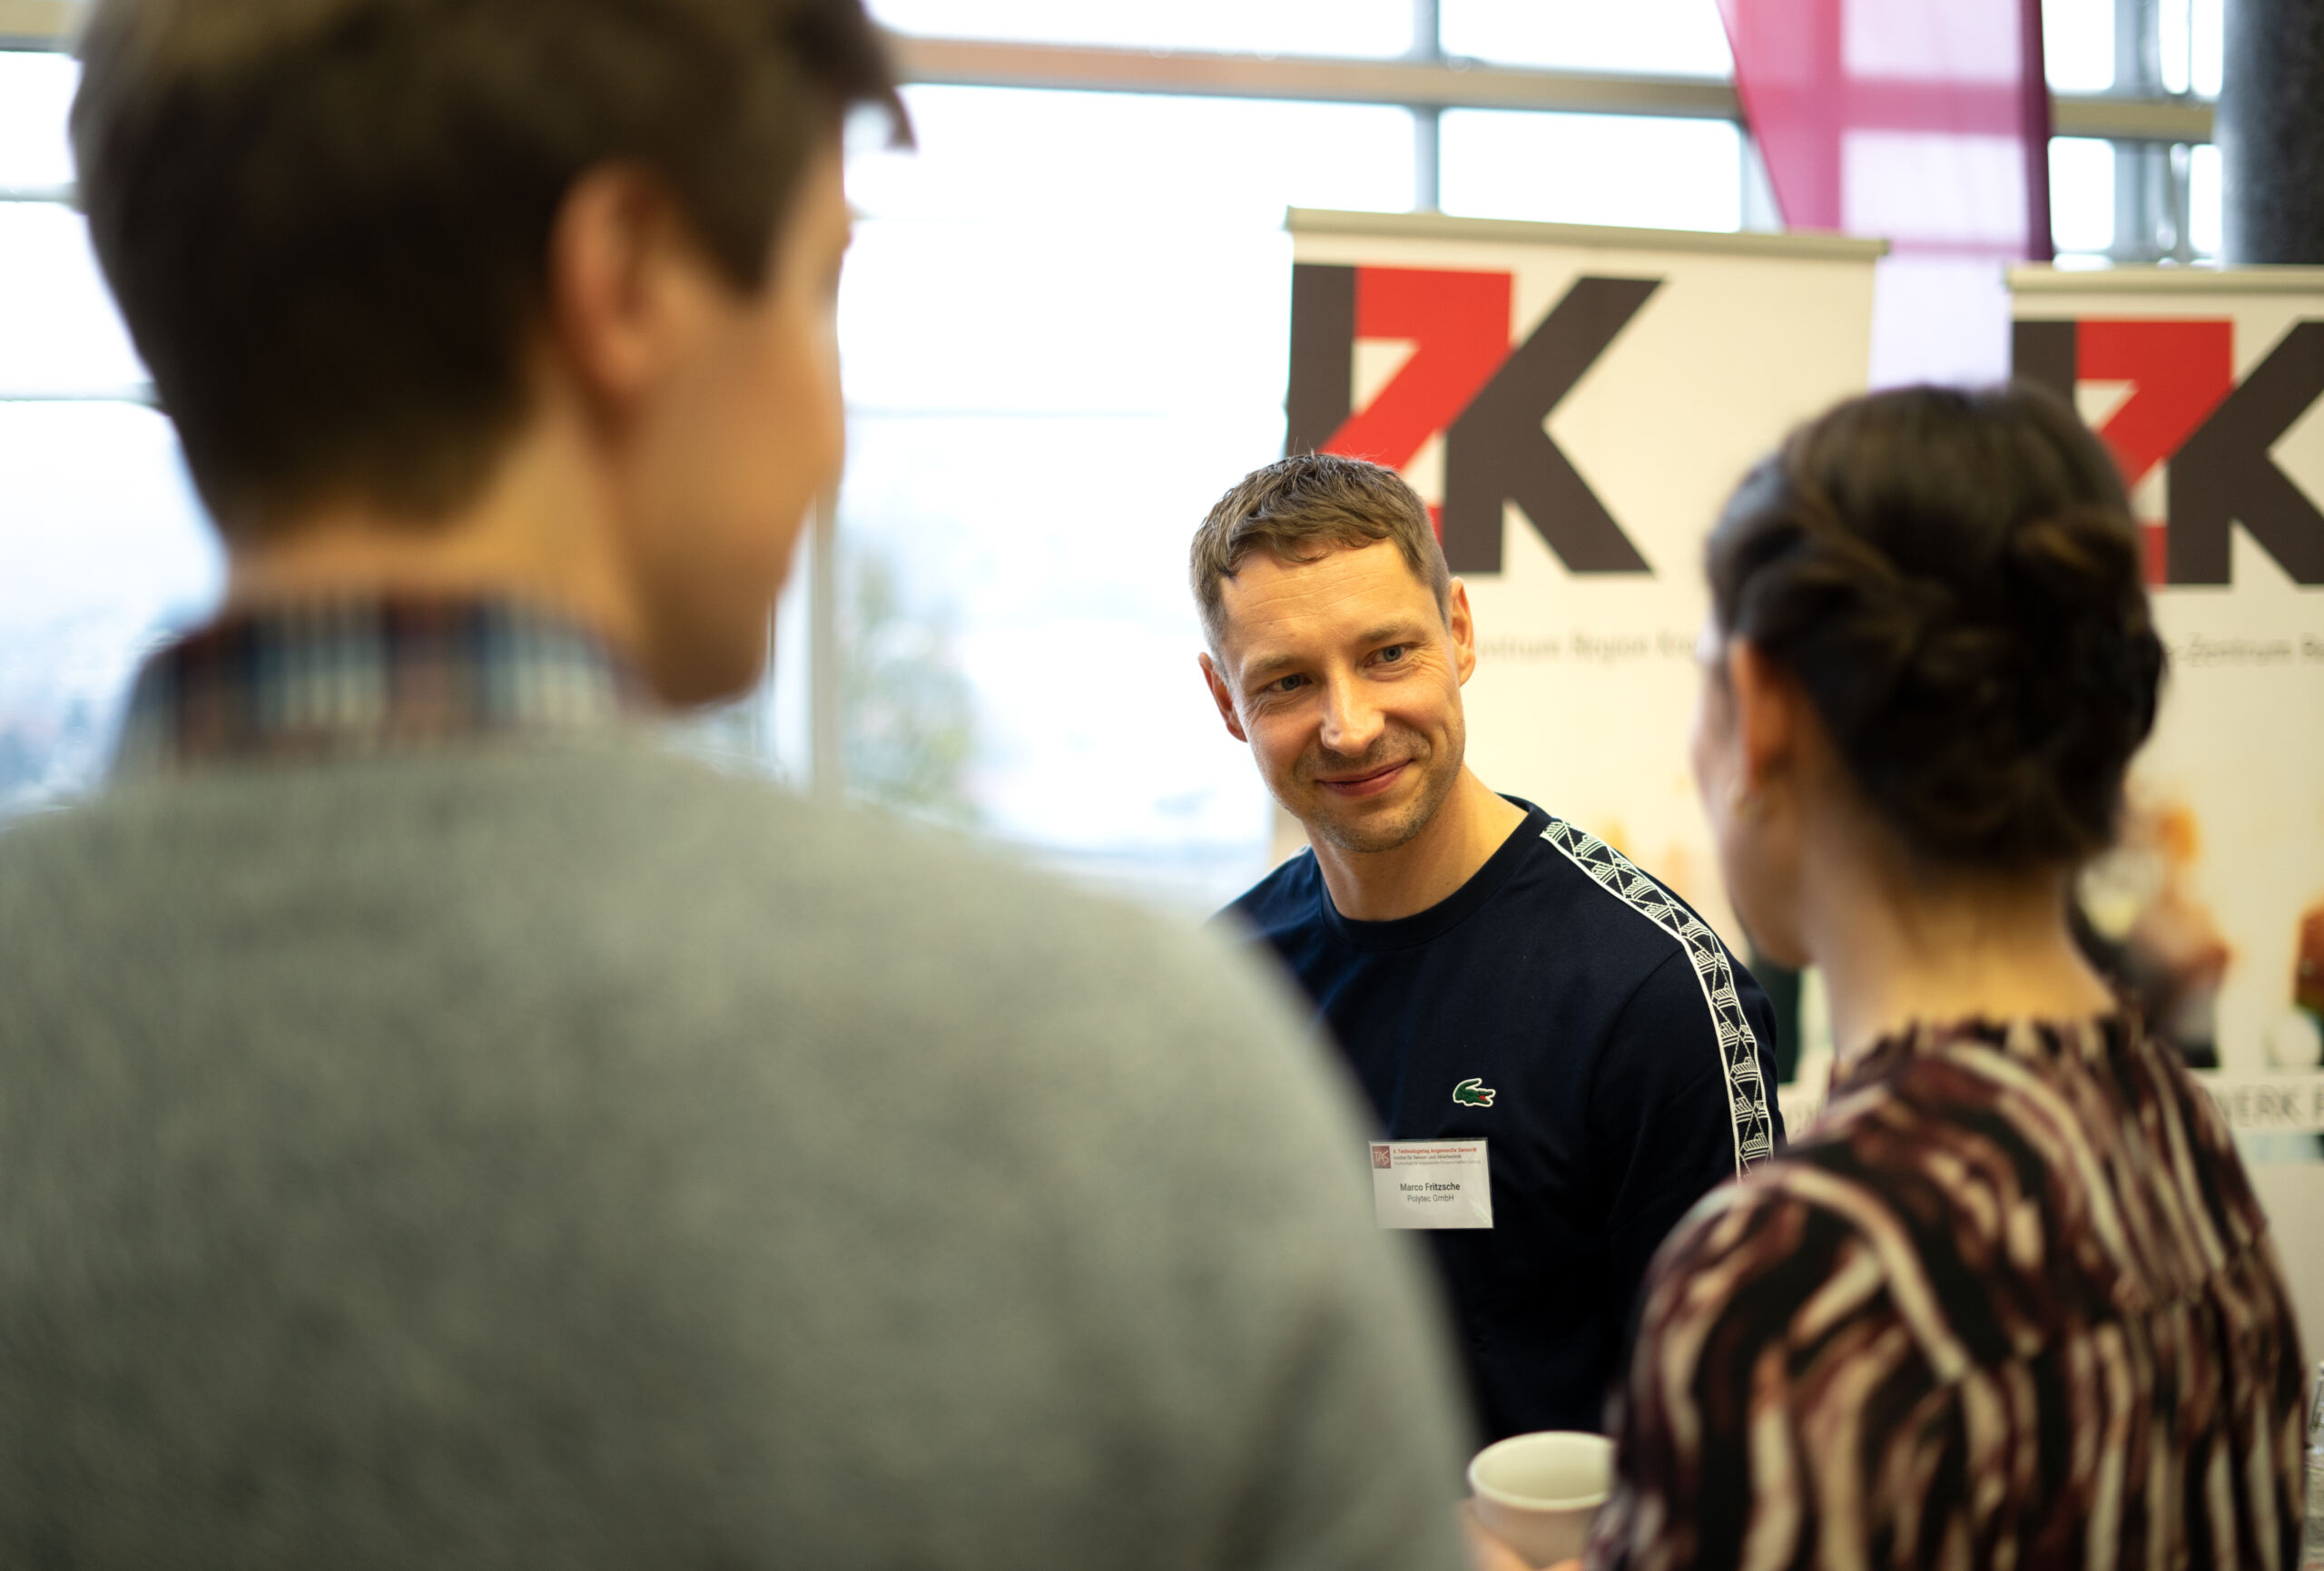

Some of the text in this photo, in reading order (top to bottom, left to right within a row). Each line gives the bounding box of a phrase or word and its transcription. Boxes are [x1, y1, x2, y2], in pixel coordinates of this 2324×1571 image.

[1400, 1182, 1461, 1192] Marco Fritzsche
[1407, 1193, 1454, 1204] Polytec GmbH
